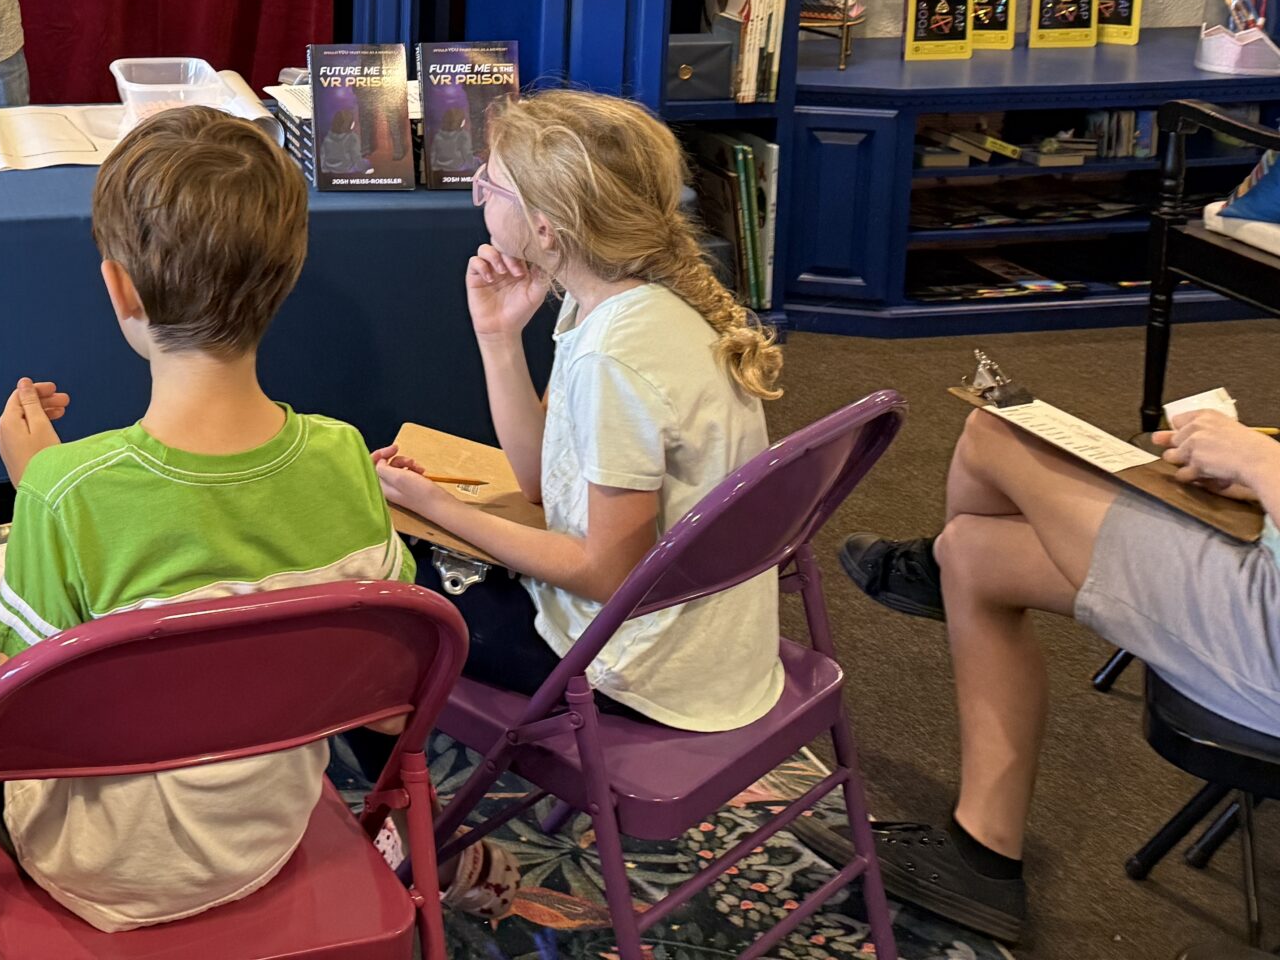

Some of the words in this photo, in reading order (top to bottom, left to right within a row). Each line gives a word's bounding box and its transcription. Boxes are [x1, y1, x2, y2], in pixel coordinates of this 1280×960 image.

[320, 67, 361, 76] FUTURE
[363, 67, 380, 76] ME
[429, 64, 472, 73] FUTURE
[474, 63, 491, 73] ME
[320, 77, 342, 88] VR
[429, 74, 451, 85] VR
[456, 73, 514, 85] PRISON
